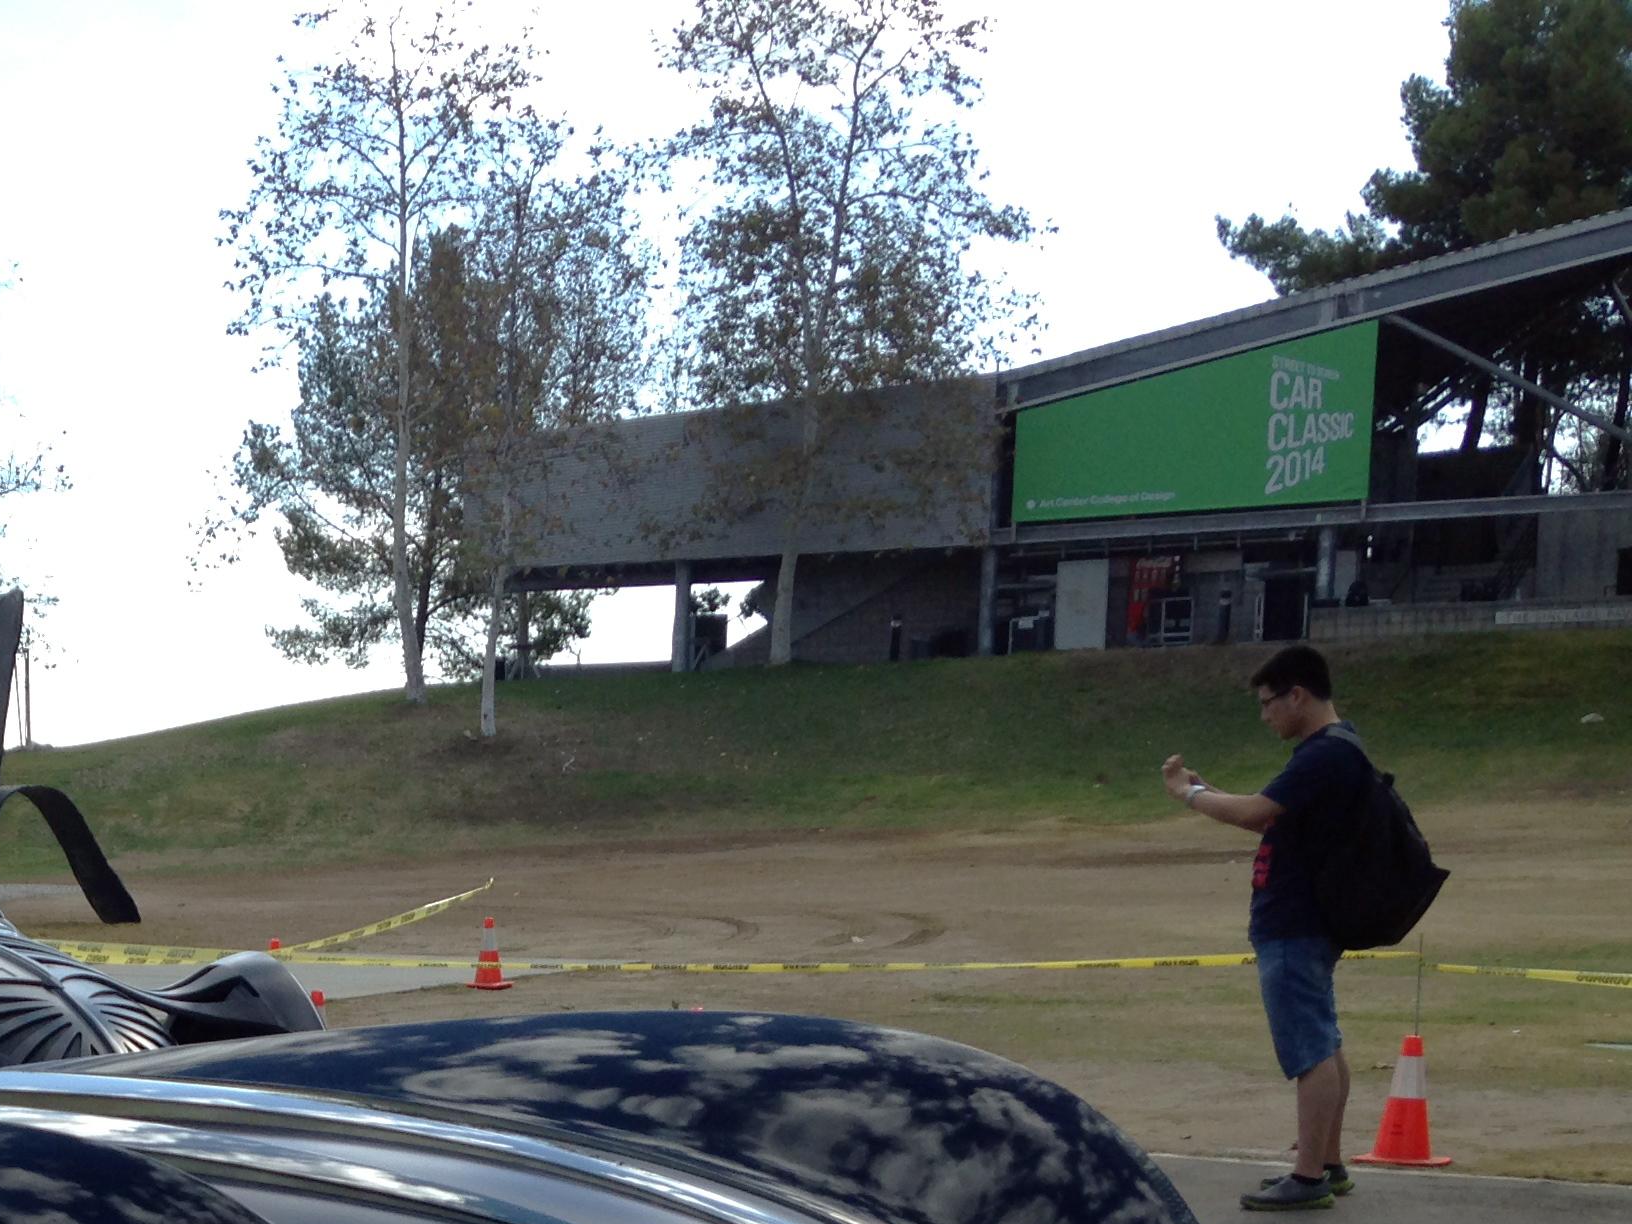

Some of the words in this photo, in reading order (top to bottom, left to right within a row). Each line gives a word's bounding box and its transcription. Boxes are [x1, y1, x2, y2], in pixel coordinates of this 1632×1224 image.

[1270, 370, 1322, 410] CAR
[1268, 412, 1354, 451] CLASSIC
[1265, 446, 1325, 494] 2014
